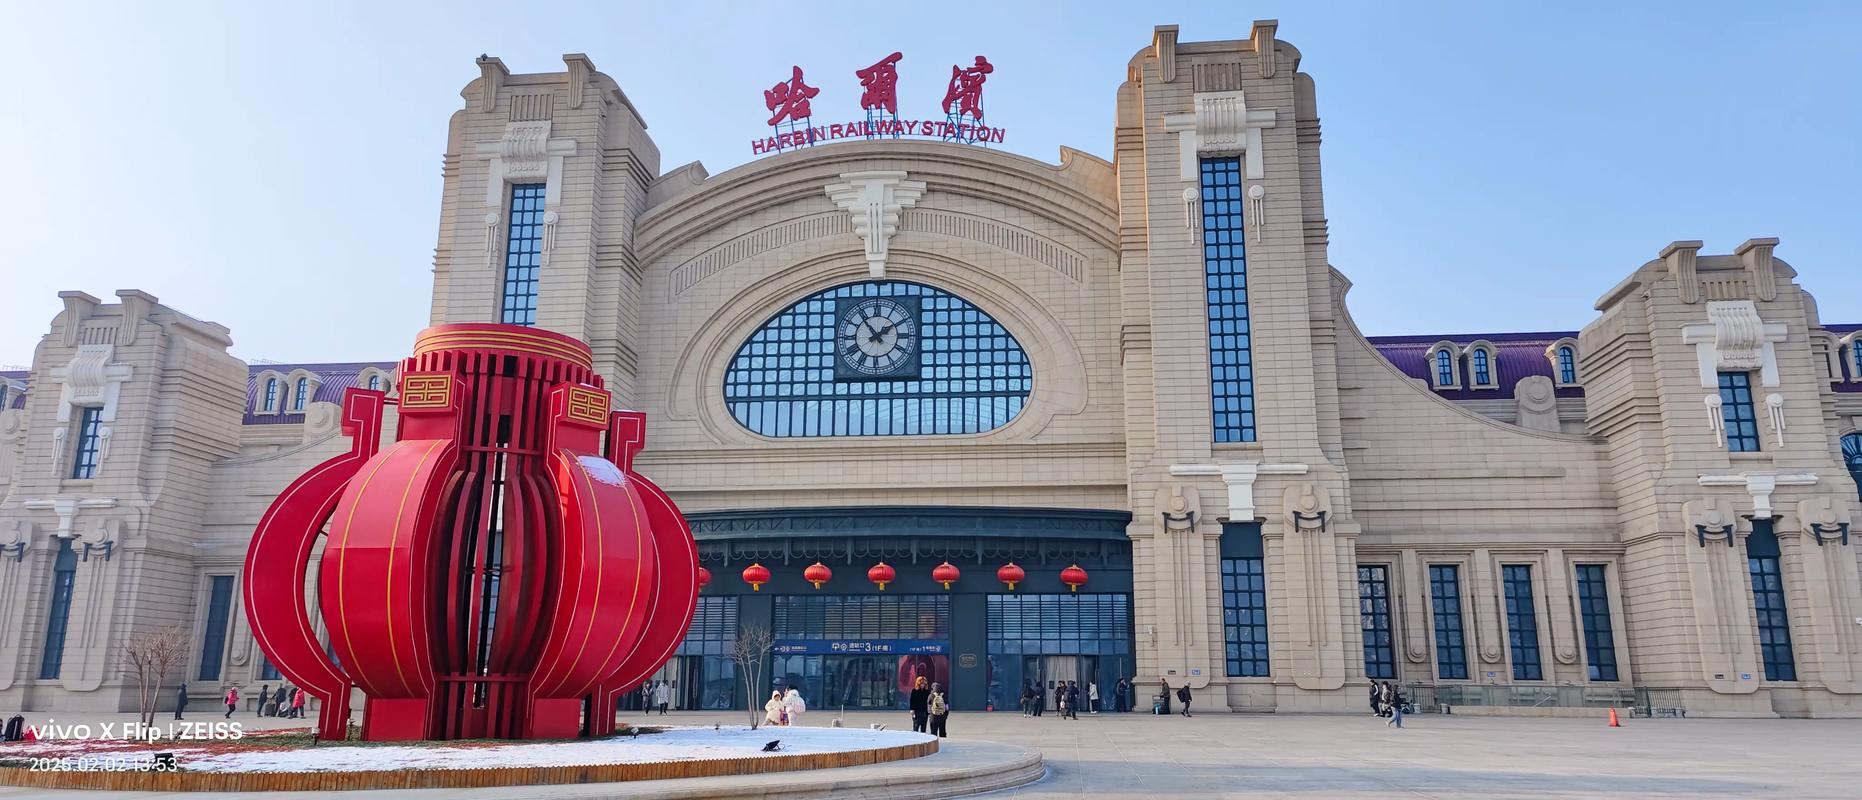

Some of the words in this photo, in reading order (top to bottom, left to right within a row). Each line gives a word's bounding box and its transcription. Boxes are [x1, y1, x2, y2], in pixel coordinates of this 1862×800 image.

[752, 126, 826, 155] HARBIN
[830, 120, 919, 140] RAILWAY
[921, 120, 1006, 143] STATION
